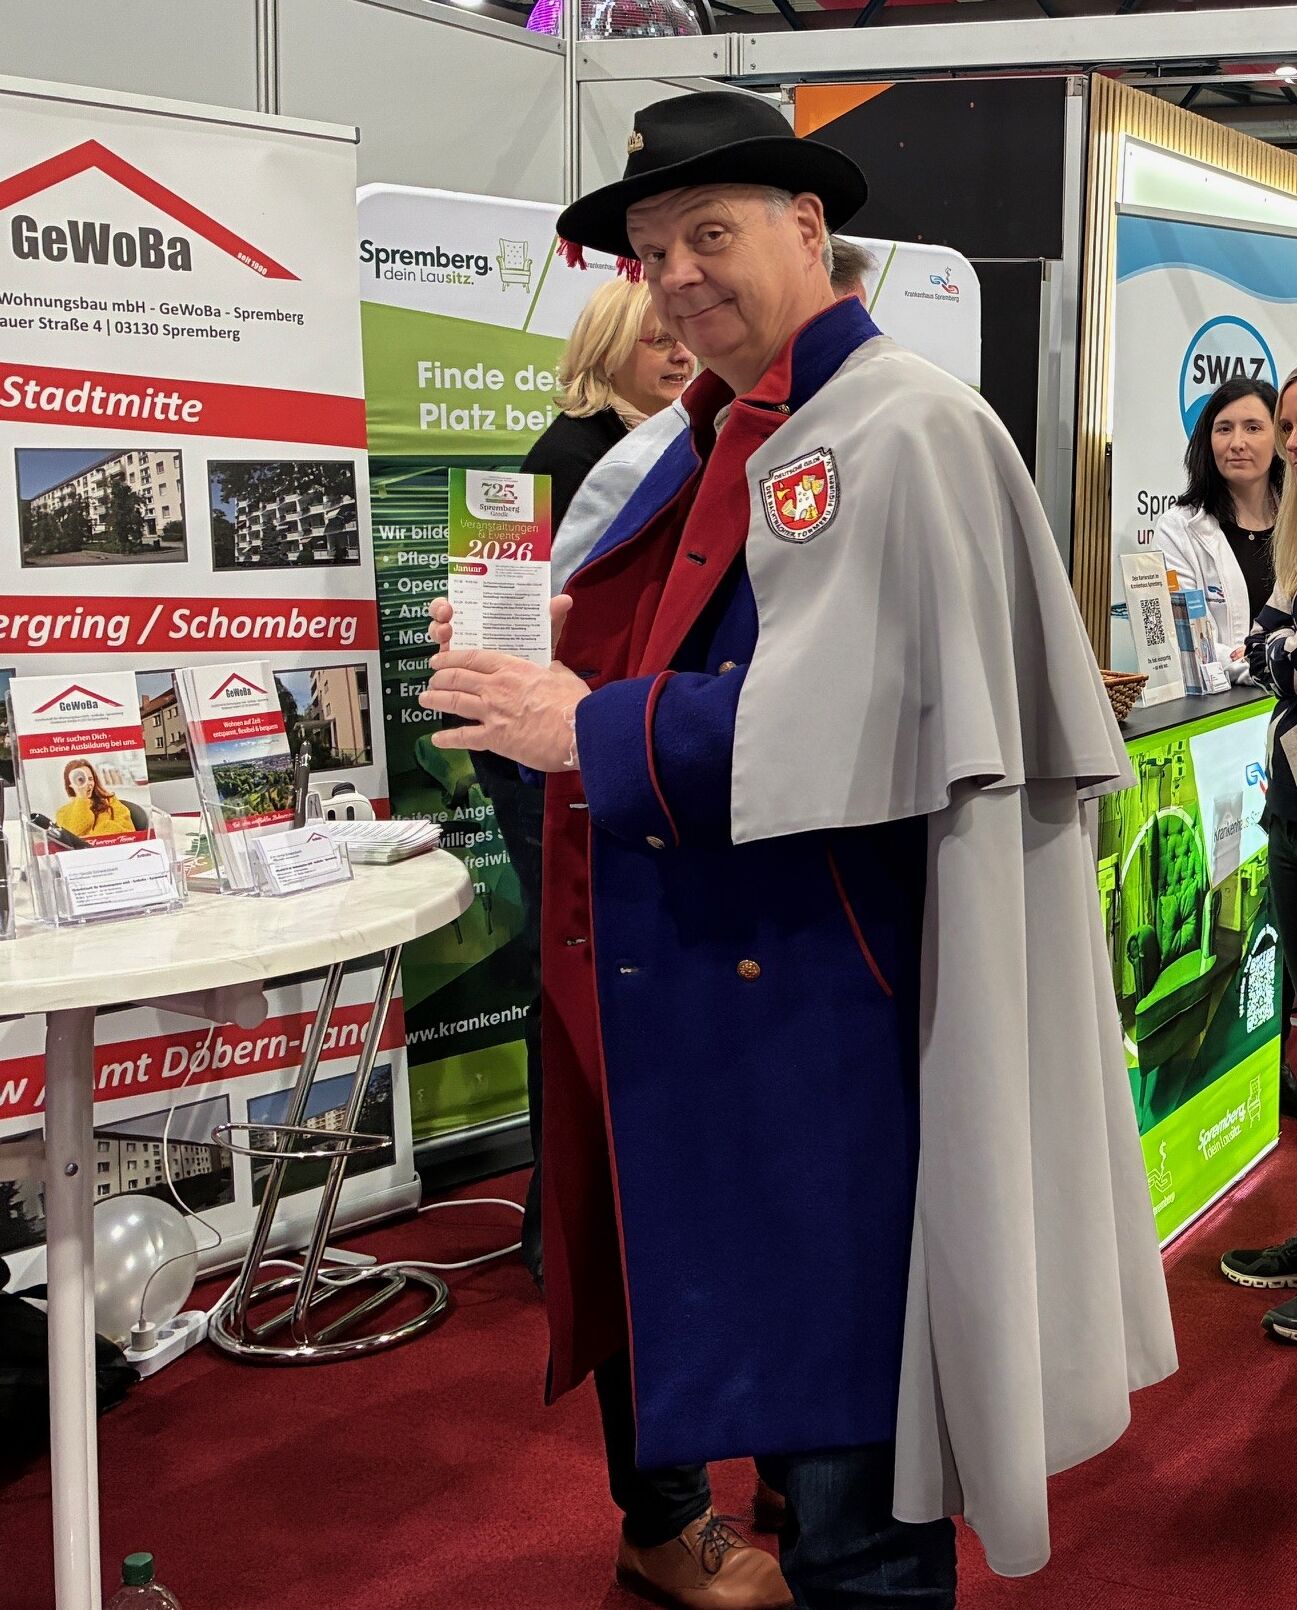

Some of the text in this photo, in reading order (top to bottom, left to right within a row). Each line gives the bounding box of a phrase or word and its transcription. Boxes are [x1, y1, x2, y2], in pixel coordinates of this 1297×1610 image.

[11, 214, 193, 272] GeWoBa
[251, 260, 268, 275] 1990
[359, 239, 493, 279] Spremberg.
[384, 266, 475, 286] dein Lausitz.
[112, 299, 146, 314] mbH
[159, 302, 222, 318] GeWoBa
[233, 306, 305, 326] Spremberg
[38, 317, 89, 332] Straße
[92, 319, 103, 332] 4
[114, 321, 159, 335] 03130
[162, 324, 241, 342] Spremberg
[417, 361, 505, 390] Finde
[1193, 353, 1266, 385] SWAZ
[0, 375, 203, 423] Stadtmitte
[419, 403, 553, 431] Platz bei
[774, 464, 802, 480] DEUTSCHE
[480, 504, 520, 513] Spremberg
[379, 525, 407, 540] Wir
[460, 520, 539, 535] Veranstaltungen
[489, 531, 521, 541] Events
[466, 540, 534, 560] 2026
[453, 562, 482, 573] Januar
[168, 607, 358, 646] Schomberg
[59, 699, 99, 712] GeWoBa
[29, 746, 49, 754] mach
[50, 745, 70, 753] Deine
[70, 740, 110, 751] Ausbildung
[52, 736, 65, 744] Wir
[66, 734, 91, 743] suchen
[91, 733, 108, 741] Dich
[453, 804, 495, 821] Ange
[93, 1056, 152, 1090] mt
